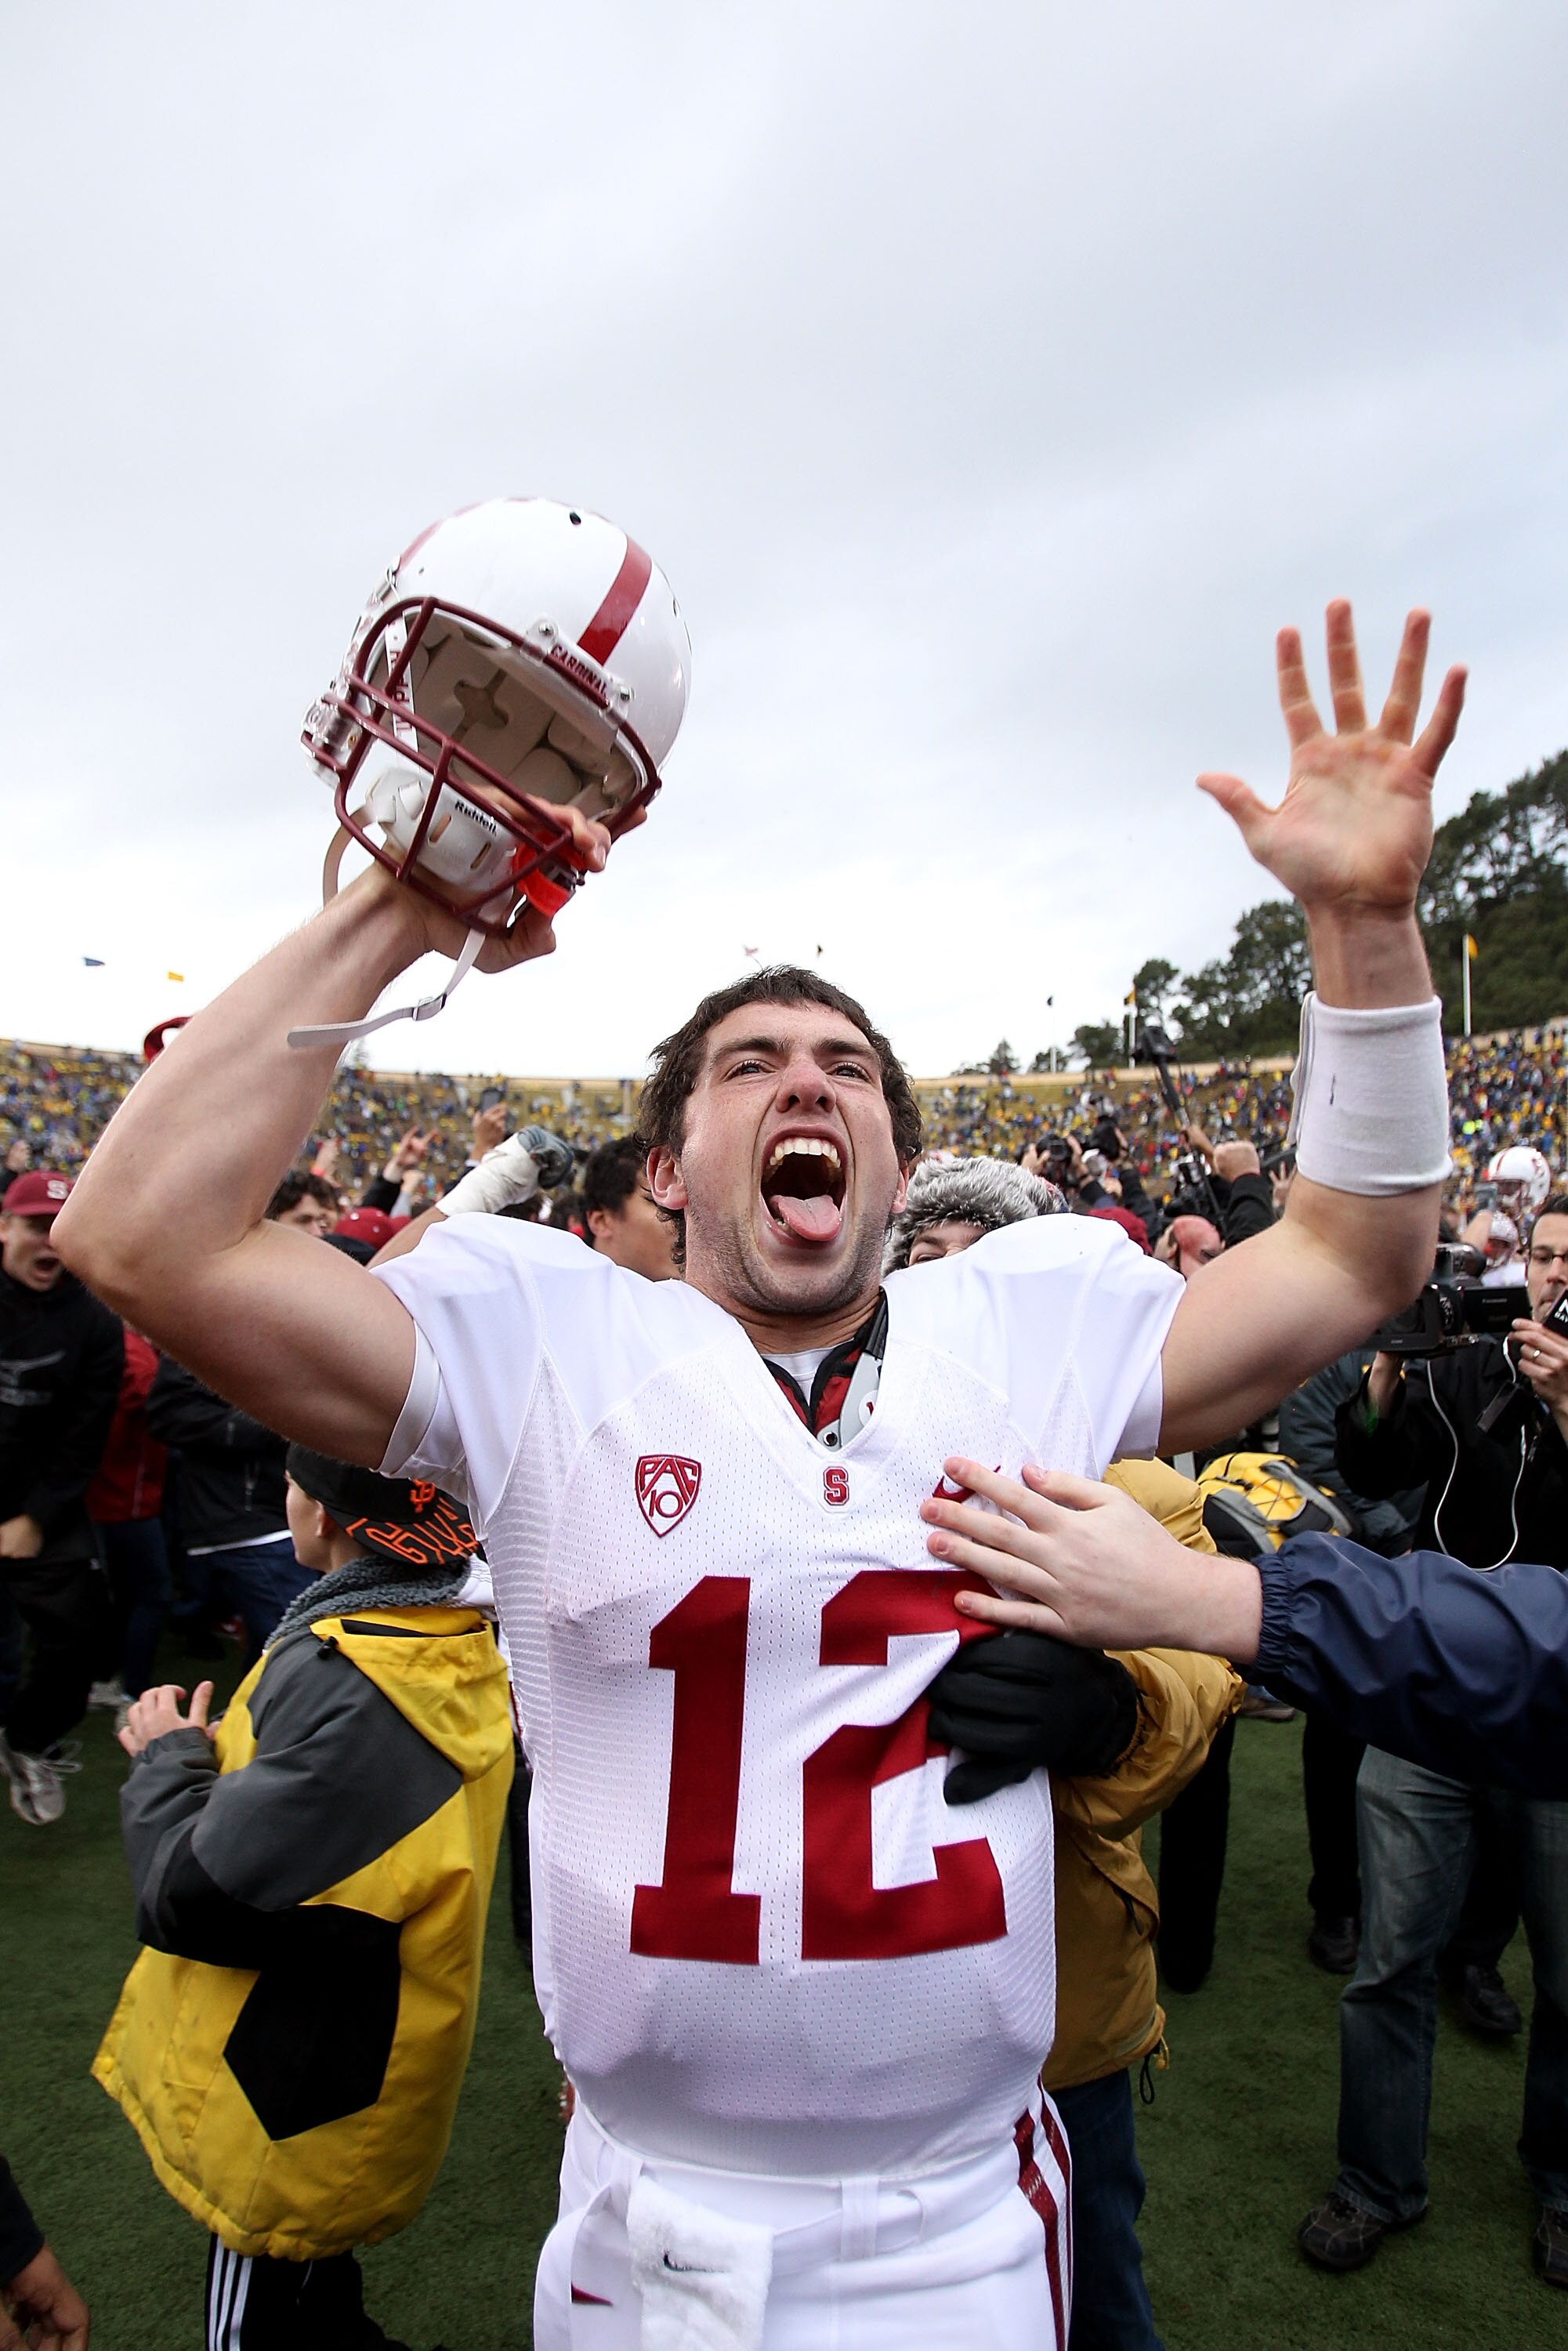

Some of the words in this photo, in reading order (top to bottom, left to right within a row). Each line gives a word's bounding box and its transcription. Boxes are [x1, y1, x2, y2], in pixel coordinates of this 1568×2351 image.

[389, 650, 412, 731] Rddll
[550, 643, 607, 697] CARDINAL
[455, 801, 497, 833] Riddell
[47, 1179, 68, 1199] S
[639, 1456, 697, 1505] PAC
[823, 1465, 849, 1506] S
[648, 1490, 684, 1518] 10
[630, 1570, 1008, 1965] 12
